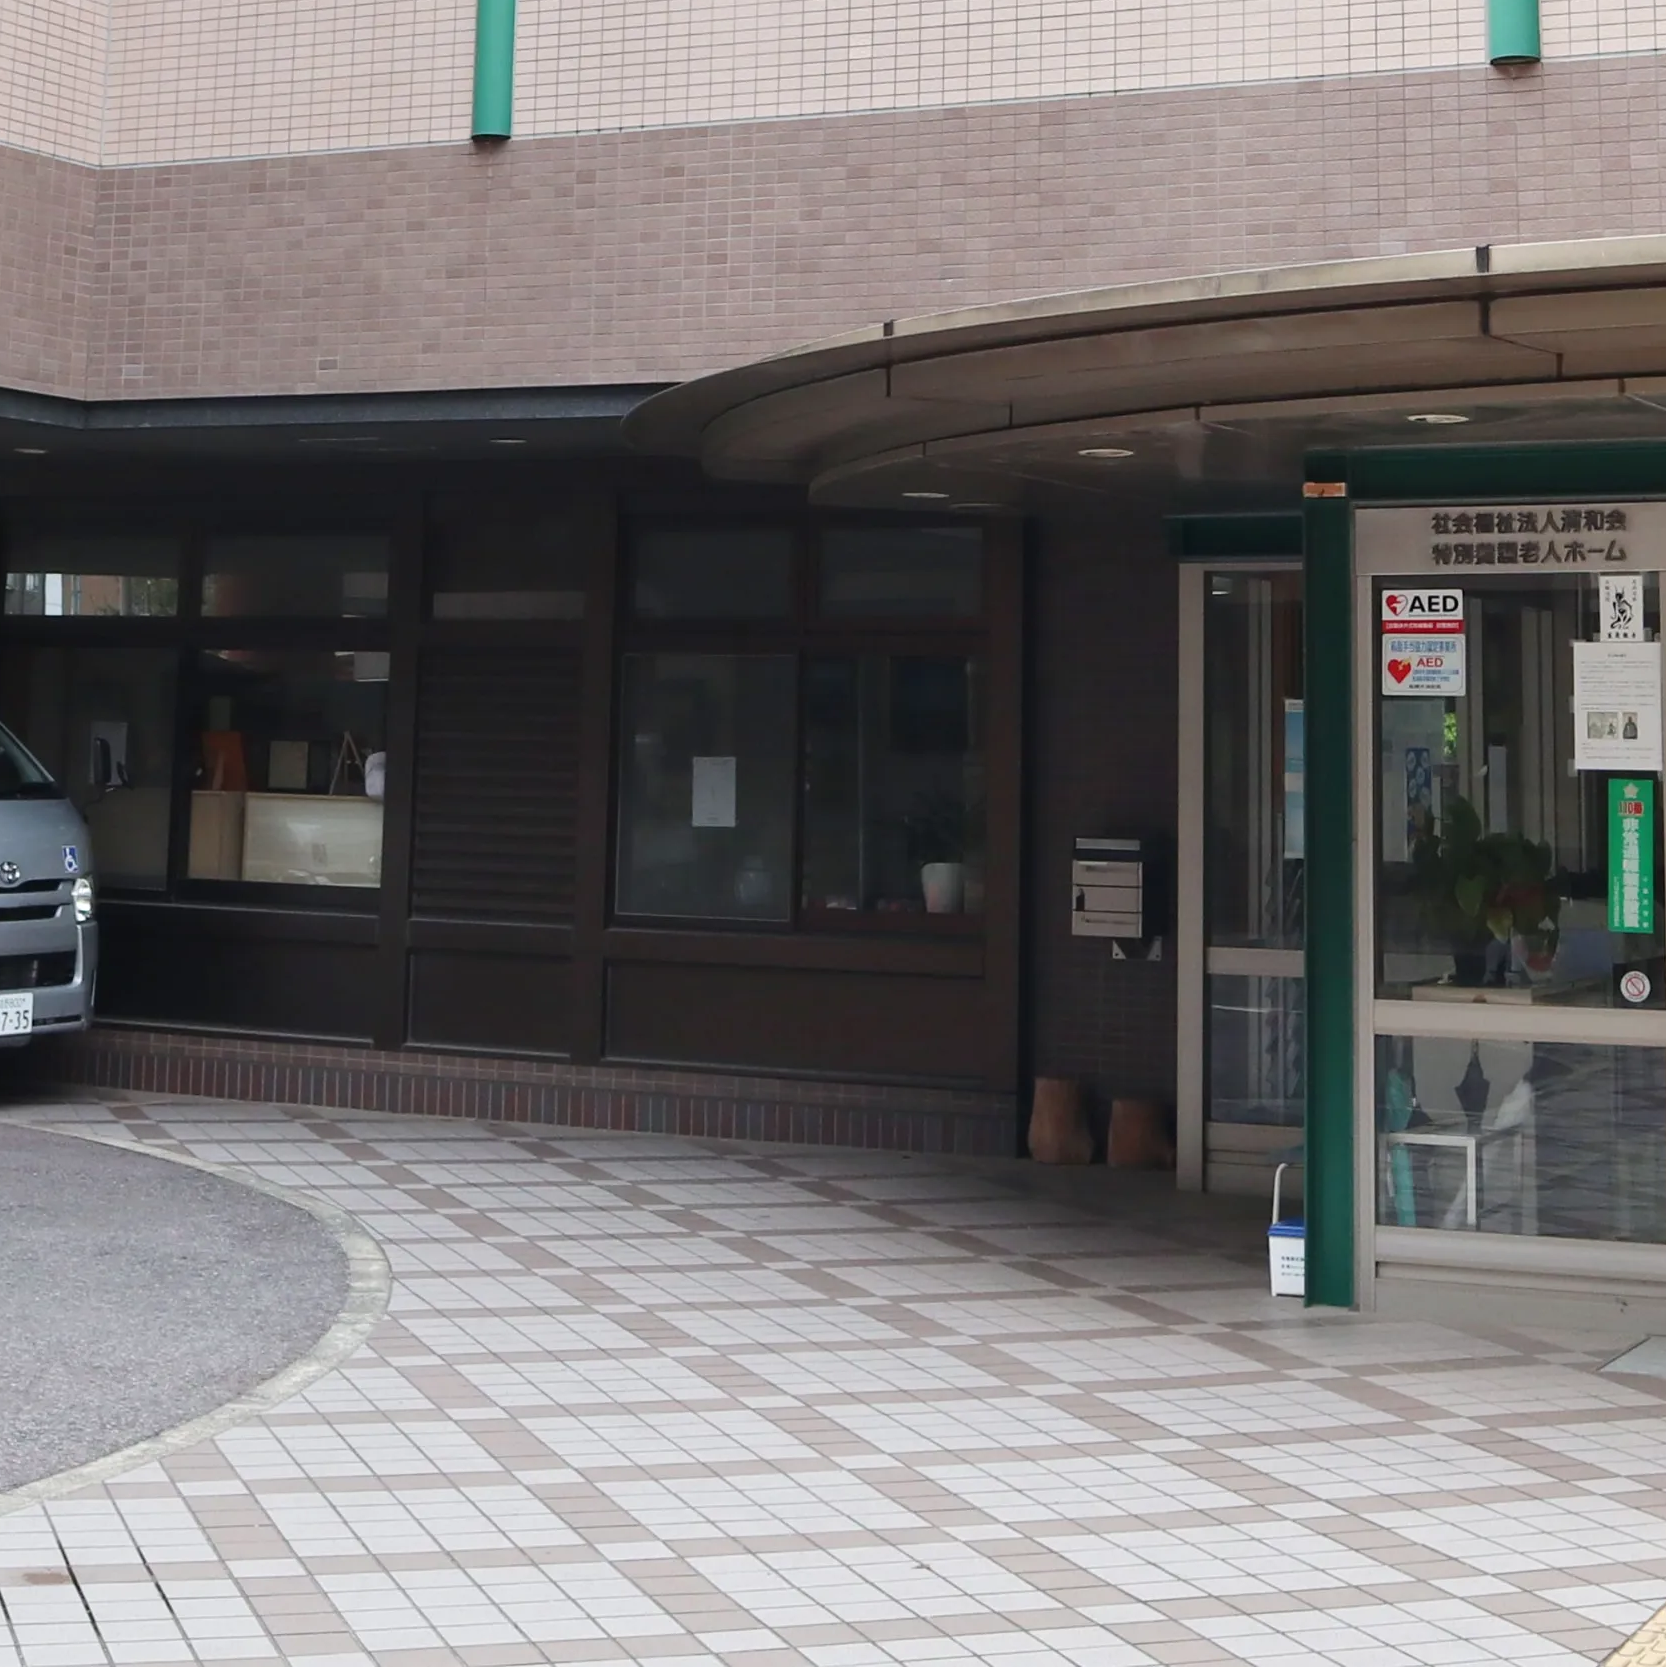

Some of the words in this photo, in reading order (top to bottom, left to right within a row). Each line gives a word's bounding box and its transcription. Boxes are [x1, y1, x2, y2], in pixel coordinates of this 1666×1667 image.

[1432, 539, 1627, 566] 特別養護老人ホーム
[1409, 595, 1459, 613] AED
[1416, 657, 1444, 668] AED
